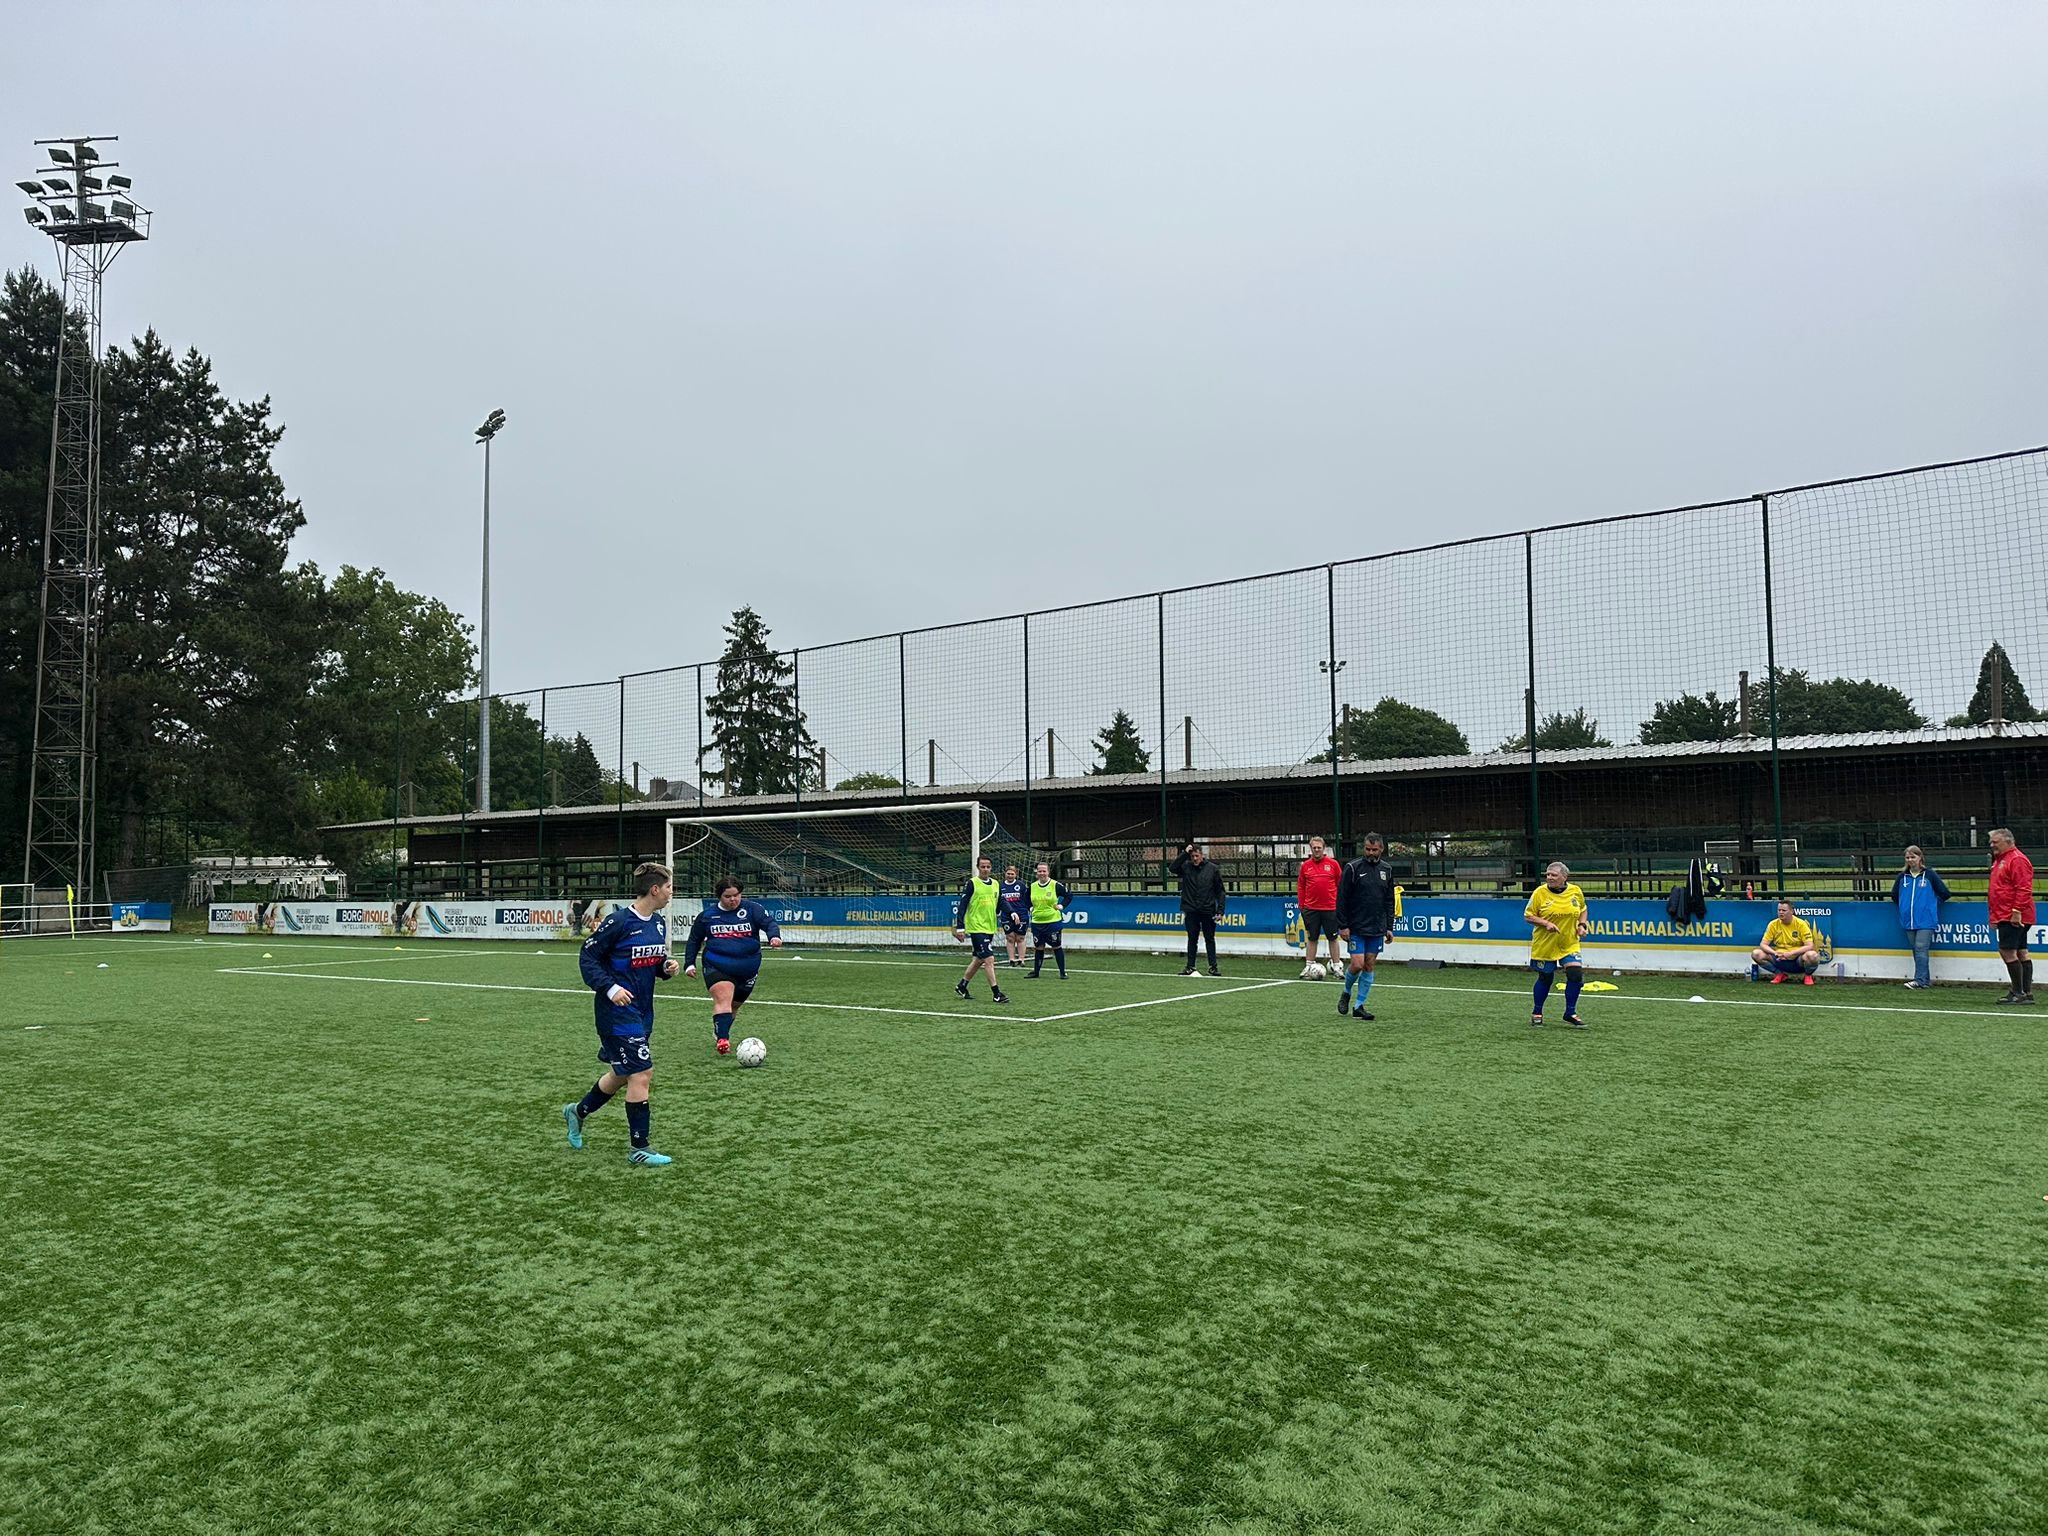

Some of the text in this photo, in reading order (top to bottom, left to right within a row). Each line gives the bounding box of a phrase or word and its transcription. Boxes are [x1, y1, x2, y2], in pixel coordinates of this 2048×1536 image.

[503, 909, 563, 925] BORGinsole
[847, 910, 925, 922] #ENALLEMAALSAMEN
[1793, 907, 1831, 916] WESTERLO
[296, 915, 329, 924] THE BEST INSOLE
[445, 915, 487, 926] THE BEST INSOLE
[711, 923, 751, 934] HEYLEN
[1393, 923, 1409, 931] EDIA
[1586, 920, 1733, 938] NALLEMAALSAMEN
[1956, 923, 1971, 933] US
[1974, 923, 1990, 933] ON
[1952, 933, 1991, 944] MEDIA
[633, 945, 665, 957] HEYLE
